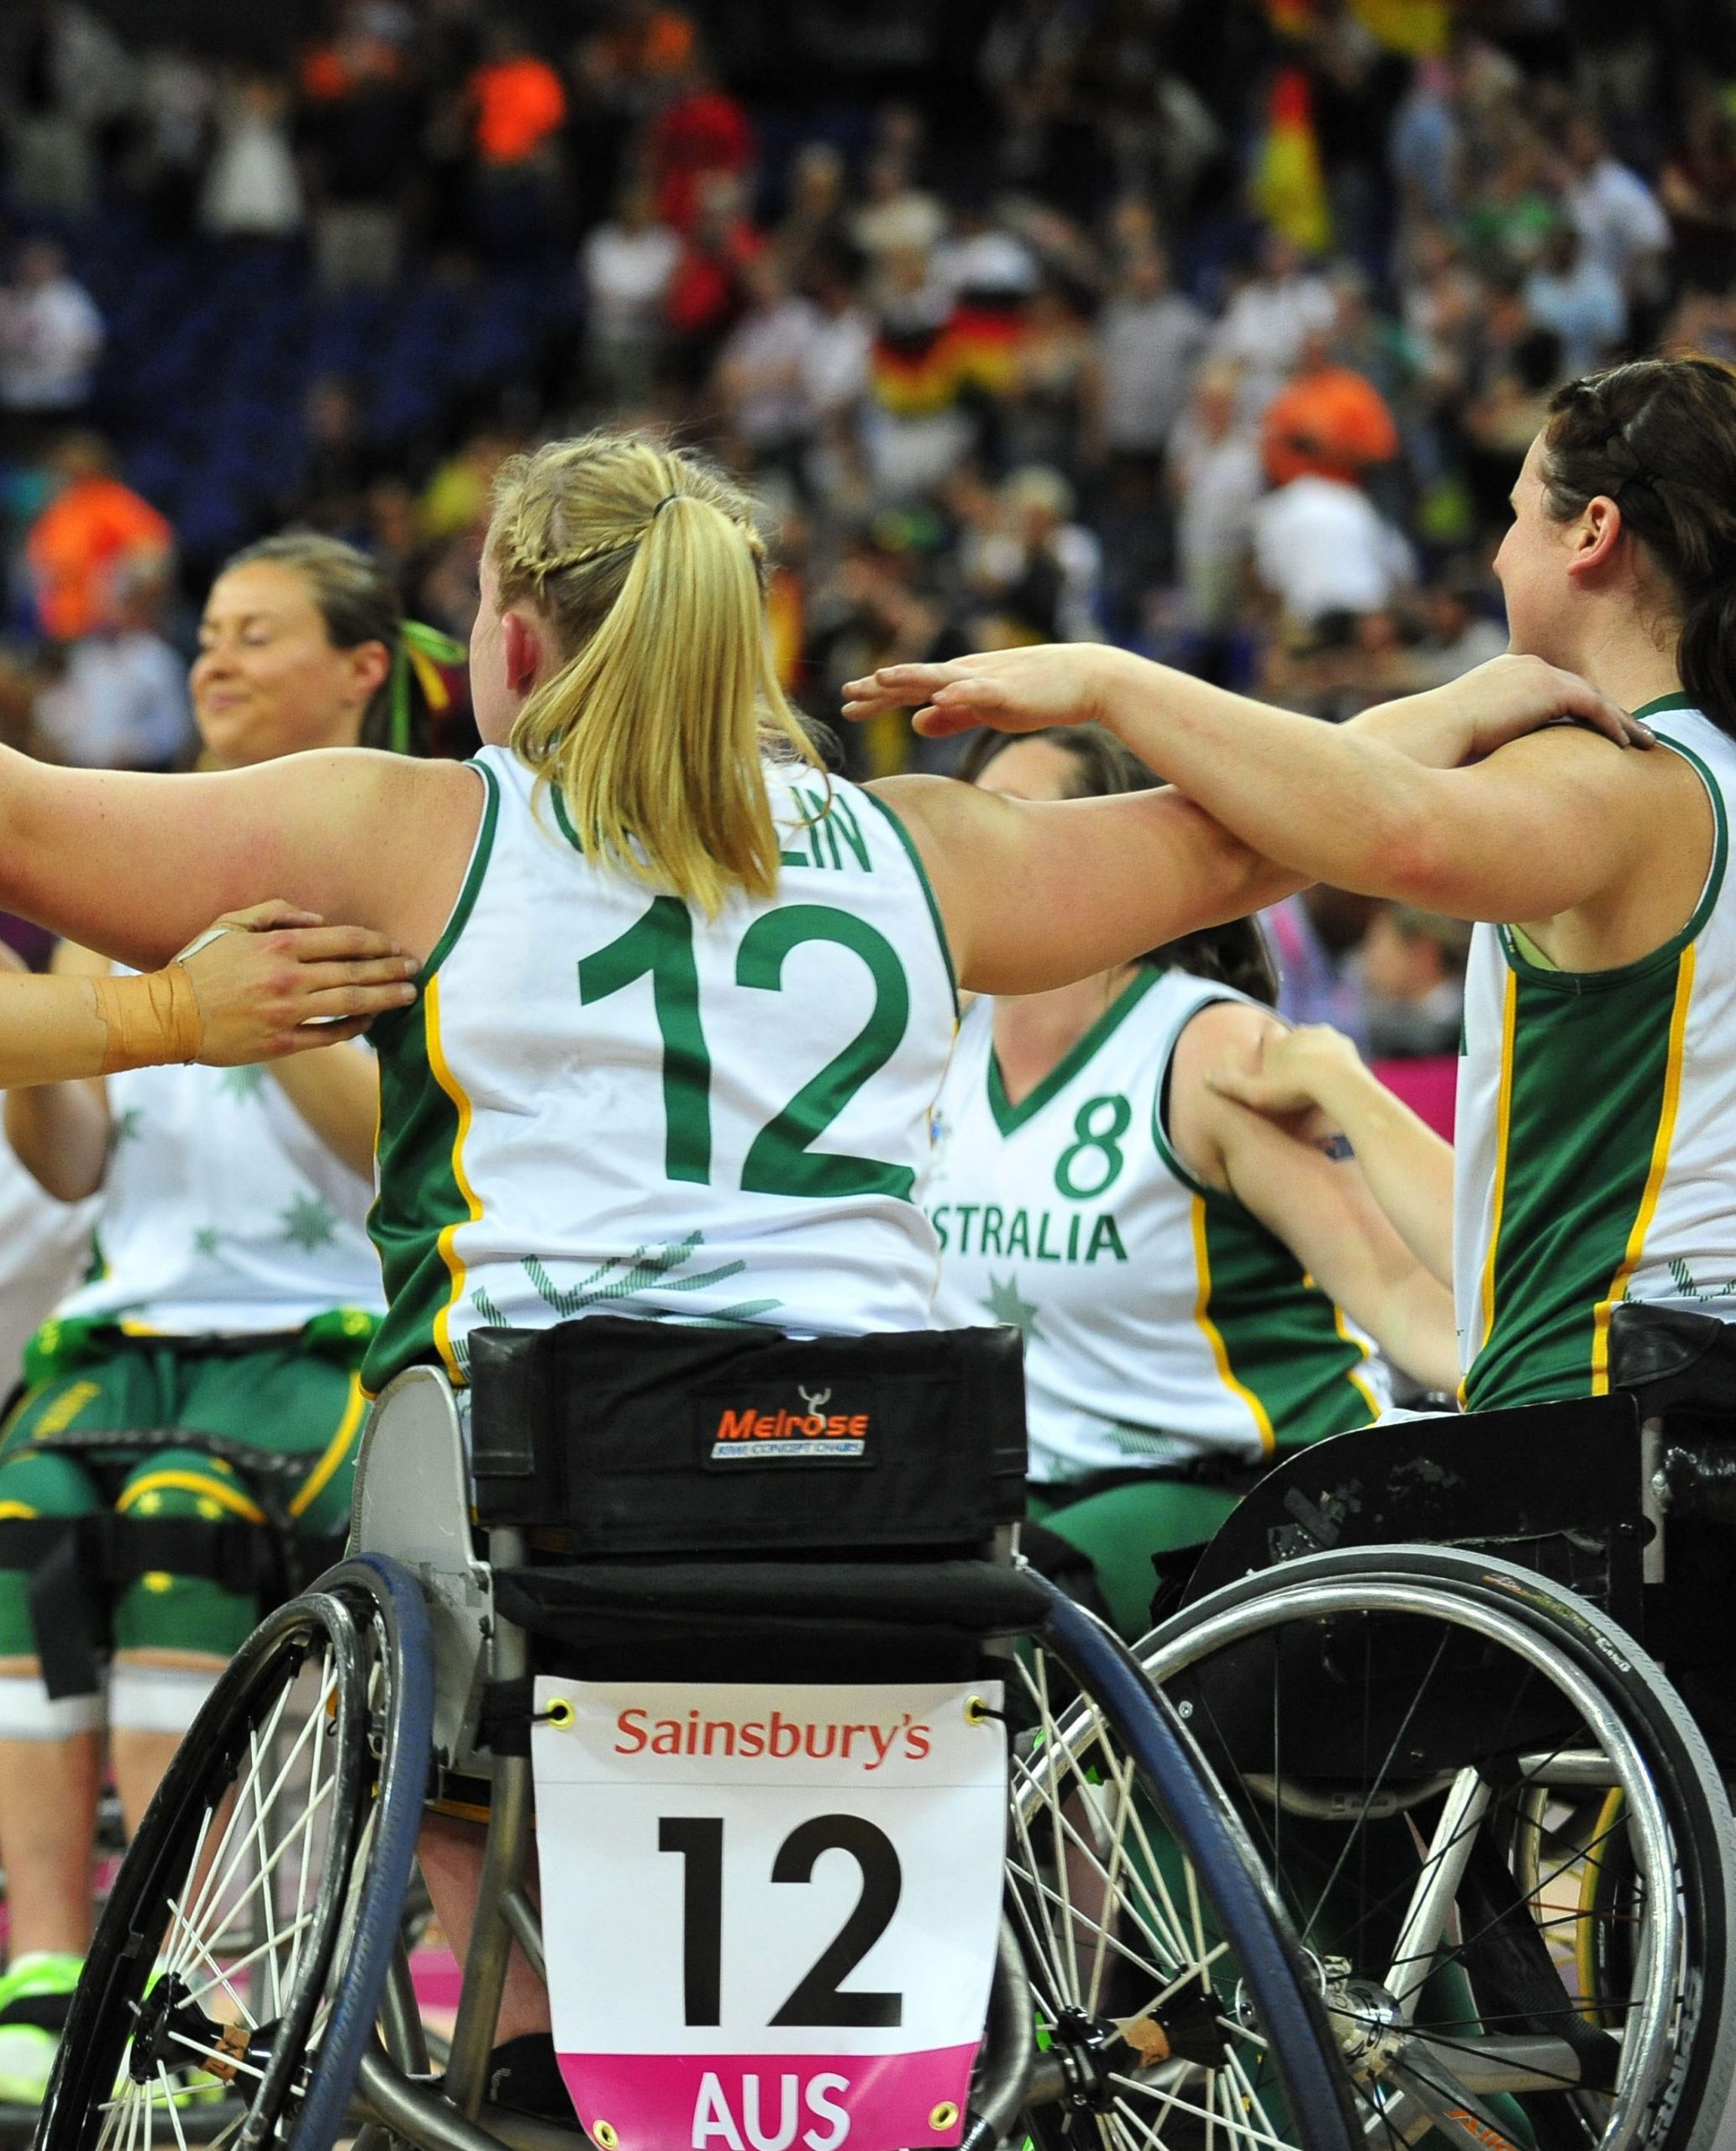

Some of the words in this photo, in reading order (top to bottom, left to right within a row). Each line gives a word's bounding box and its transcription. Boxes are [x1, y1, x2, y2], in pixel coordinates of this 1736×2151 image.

[577, 895, 915, 1202] 12
[1054, 1094, 1132, 1199] 8
[924, 1207, 1128, 1262] STRALIA
[717, 1408, 869, 1439] Melrose
[615, 1709, 931, 1770] Sainsbury's
[659, 1813, 902, 2027] 12
[691, 2072, 850, 2151] AUS
